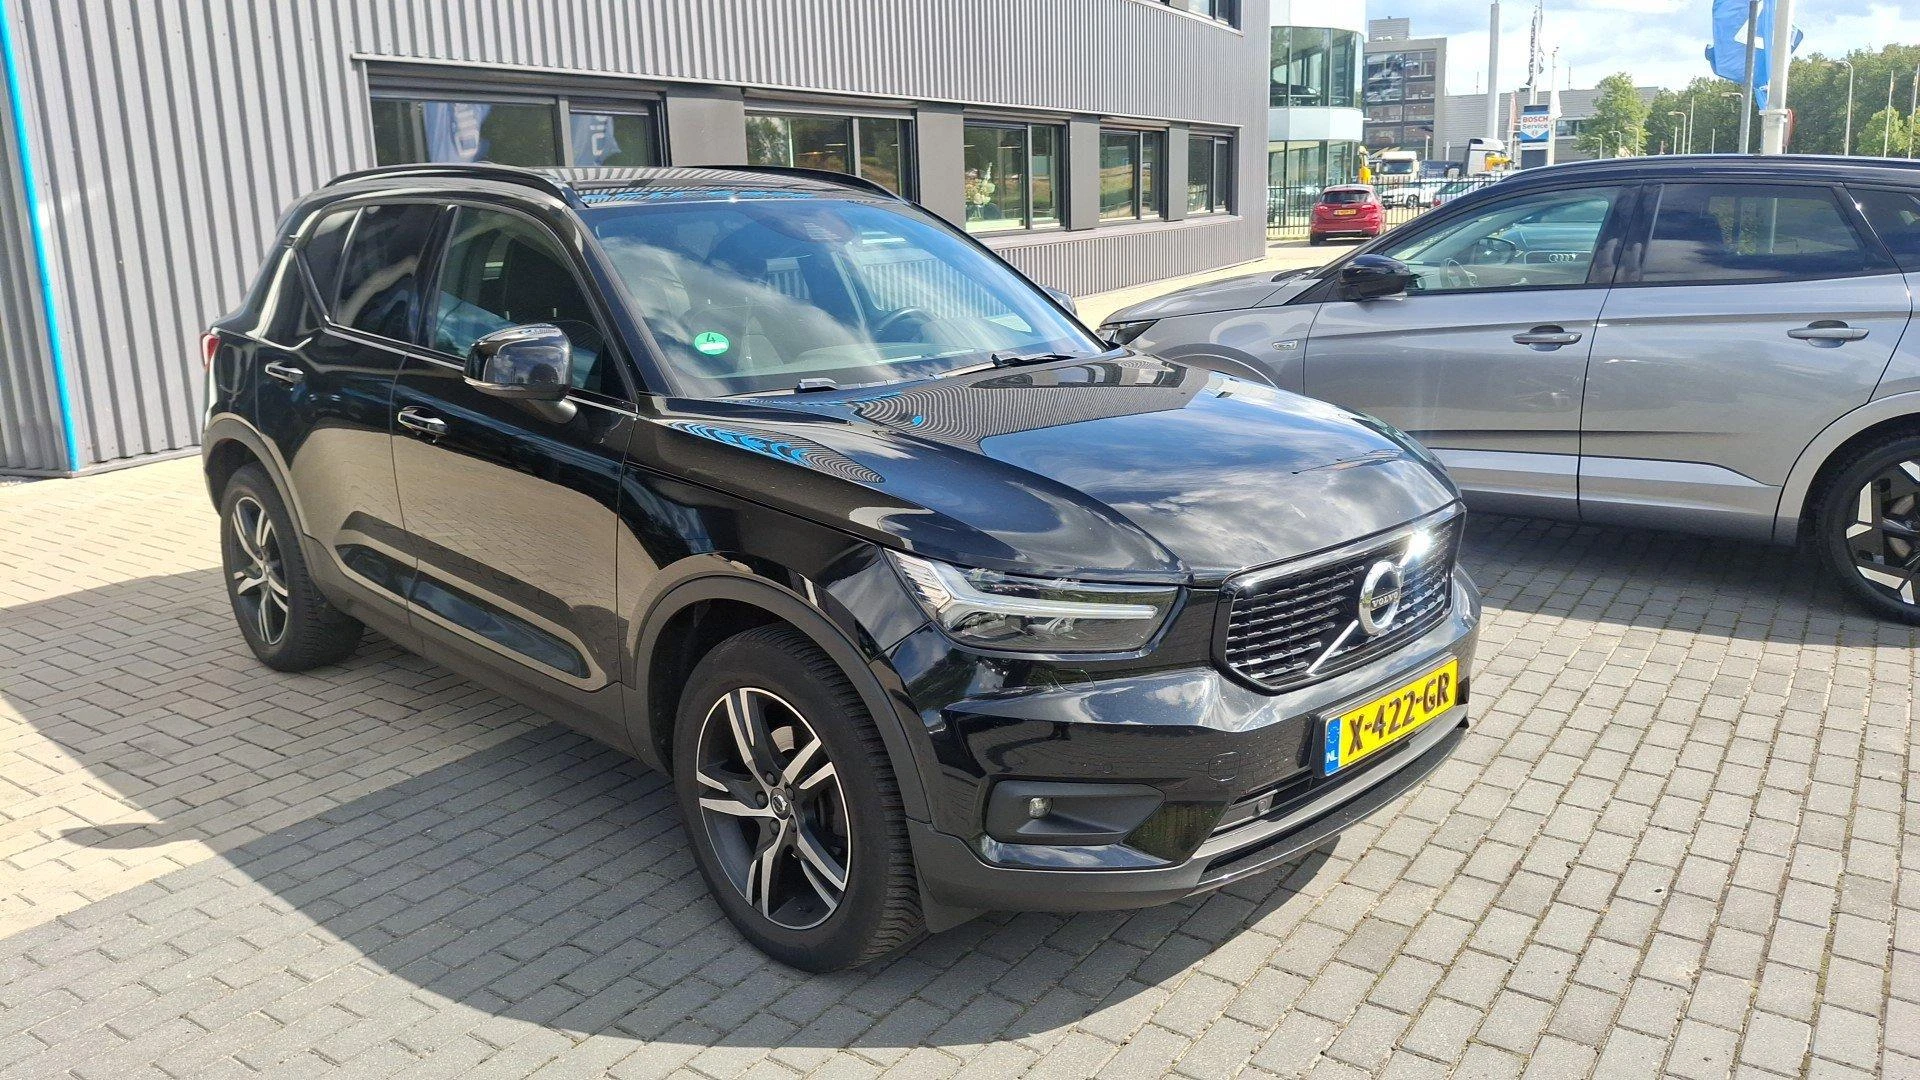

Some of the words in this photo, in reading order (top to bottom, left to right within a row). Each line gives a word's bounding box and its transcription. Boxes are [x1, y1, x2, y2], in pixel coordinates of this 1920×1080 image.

[706, 333, 716, 343] 4
[1371, 591, 1399, 608] VOLVO
[1326, 749, 1338, 763] NL
[1348, 672, 1450, 757] X-422-GR
